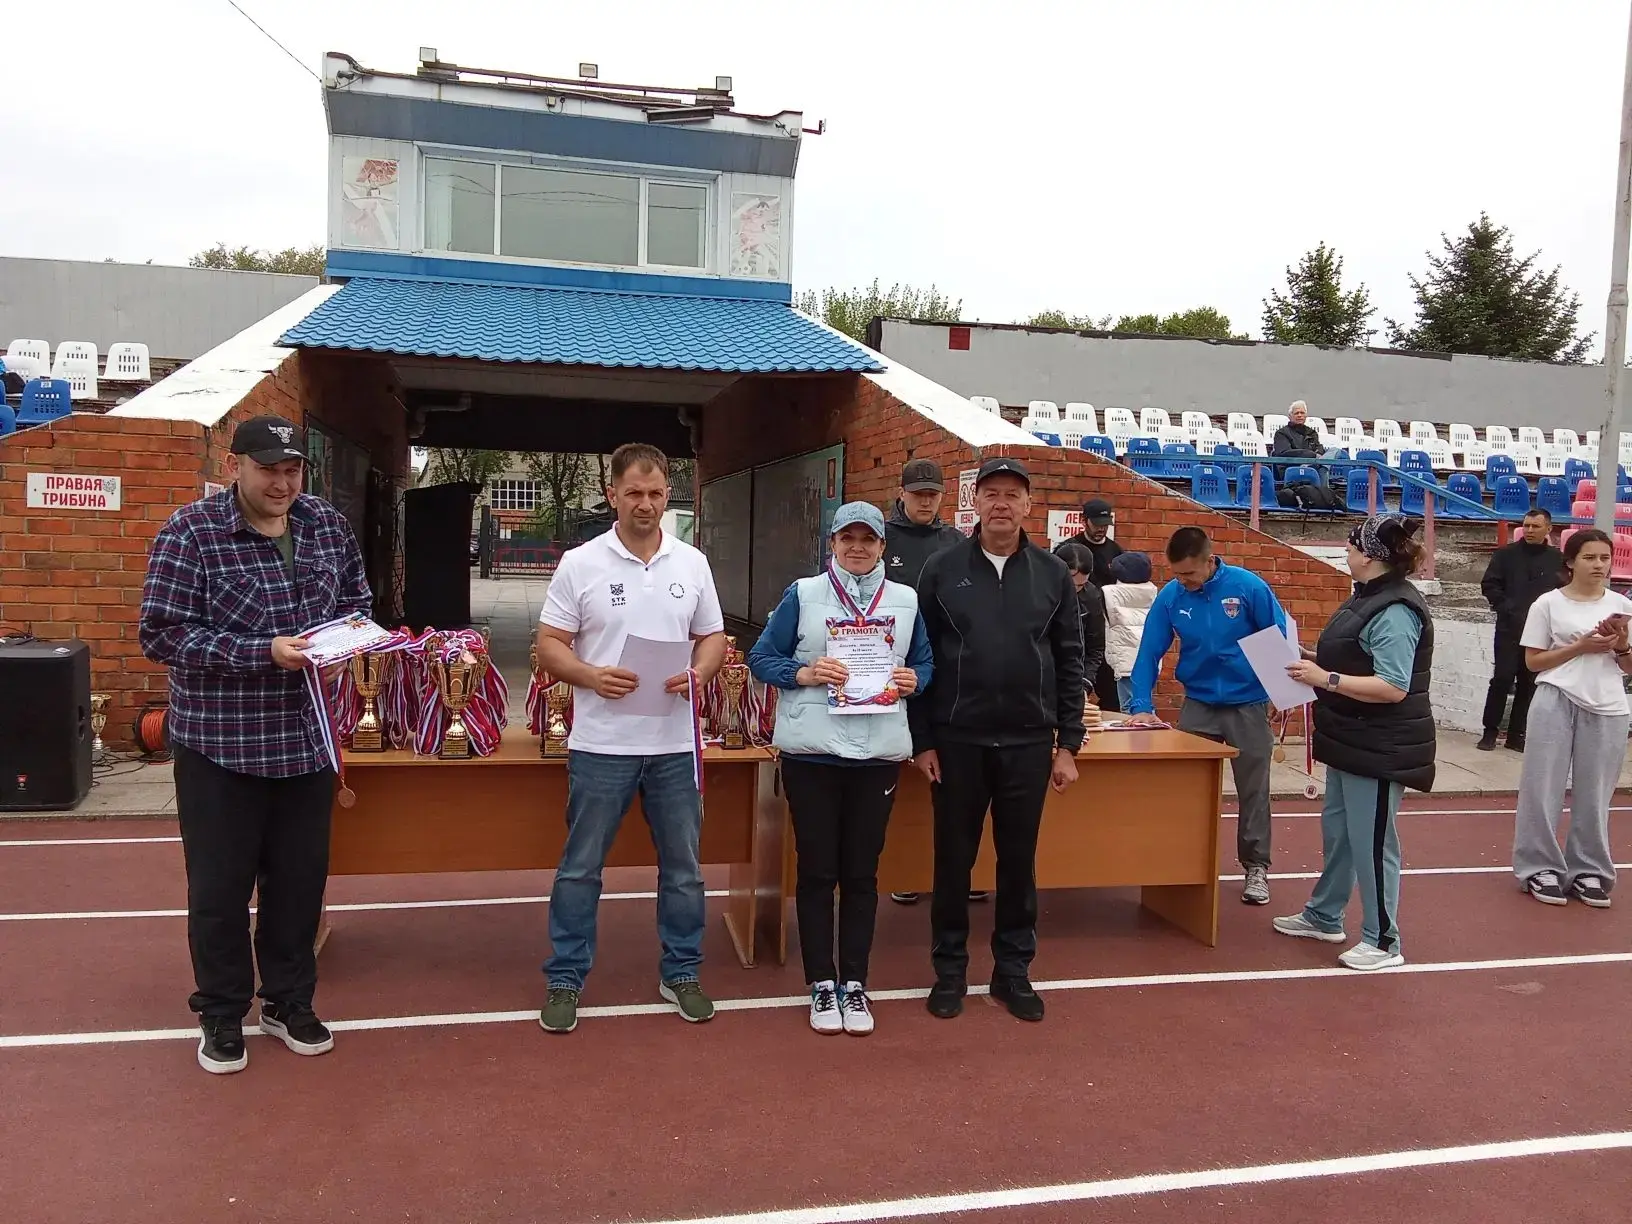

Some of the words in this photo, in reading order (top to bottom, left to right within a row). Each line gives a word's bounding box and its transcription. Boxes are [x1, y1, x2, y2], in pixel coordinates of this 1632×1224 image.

[916, 464, 935, 479] 10
[46, 476, 102, 491] ПРАВАЯ
[42, 492, 106, 508] ТРИБУНА
[1065, 512, 1085, 524] ЛЕВ
[1058, 526, 1085, 537] ТРИБ
[841, 627, 879, 635] ГРАМОТА
